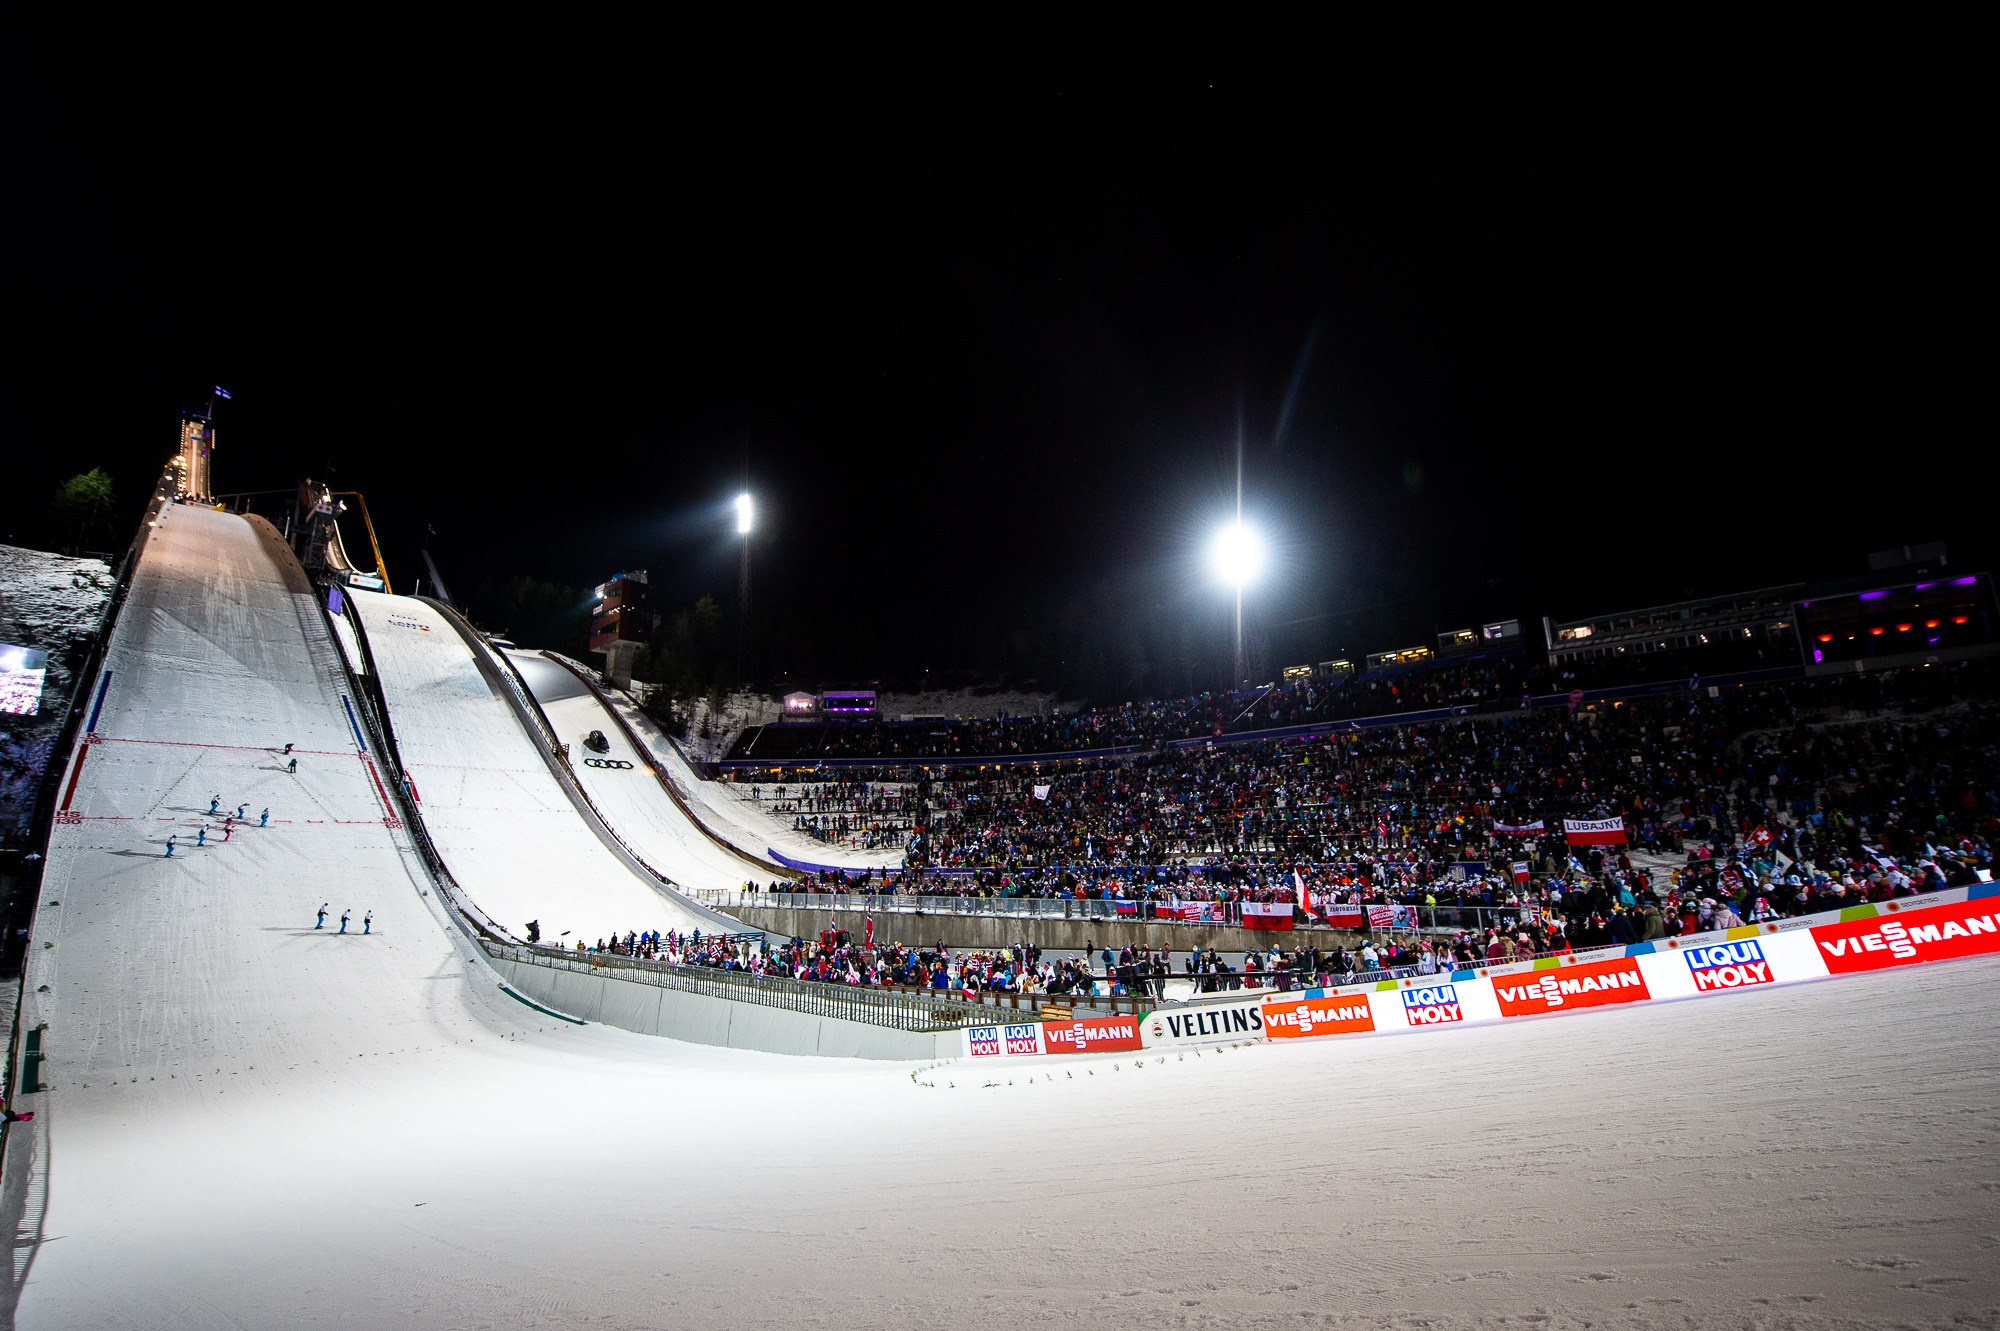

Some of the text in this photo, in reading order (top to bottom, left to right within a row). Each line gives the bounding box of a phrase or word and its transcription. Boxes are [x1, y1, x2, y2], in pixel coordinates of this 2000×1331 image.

[1566, 820, 1620, 831] LUBAJNY
[1820, 913, 2000, 959] VIESSMAN
[1687, 942, 1763, 970] LIQUI
[1693, 962, 1766, 990] MOLY
[1405, 987, 1456, 1006] LIQUI
[1497, 970, 1641, 1007] VIESSMANN
[1167, 1007, 1263, 1037] VELTINS
[1265, 1005, 1369, 1032] VIESSMANN
[1408, 1004, 1460, 1024] MOLY
[970, 1028, 997, 1042] LIQUI
[1006, 1024, 1035, 1039] LIQUI
[1047, 1023, 1134, 1049] VIESSMANN
[972, 1041, 998, 1055] MOLY
[1008, 1038, 1037, 1053] MOLY
